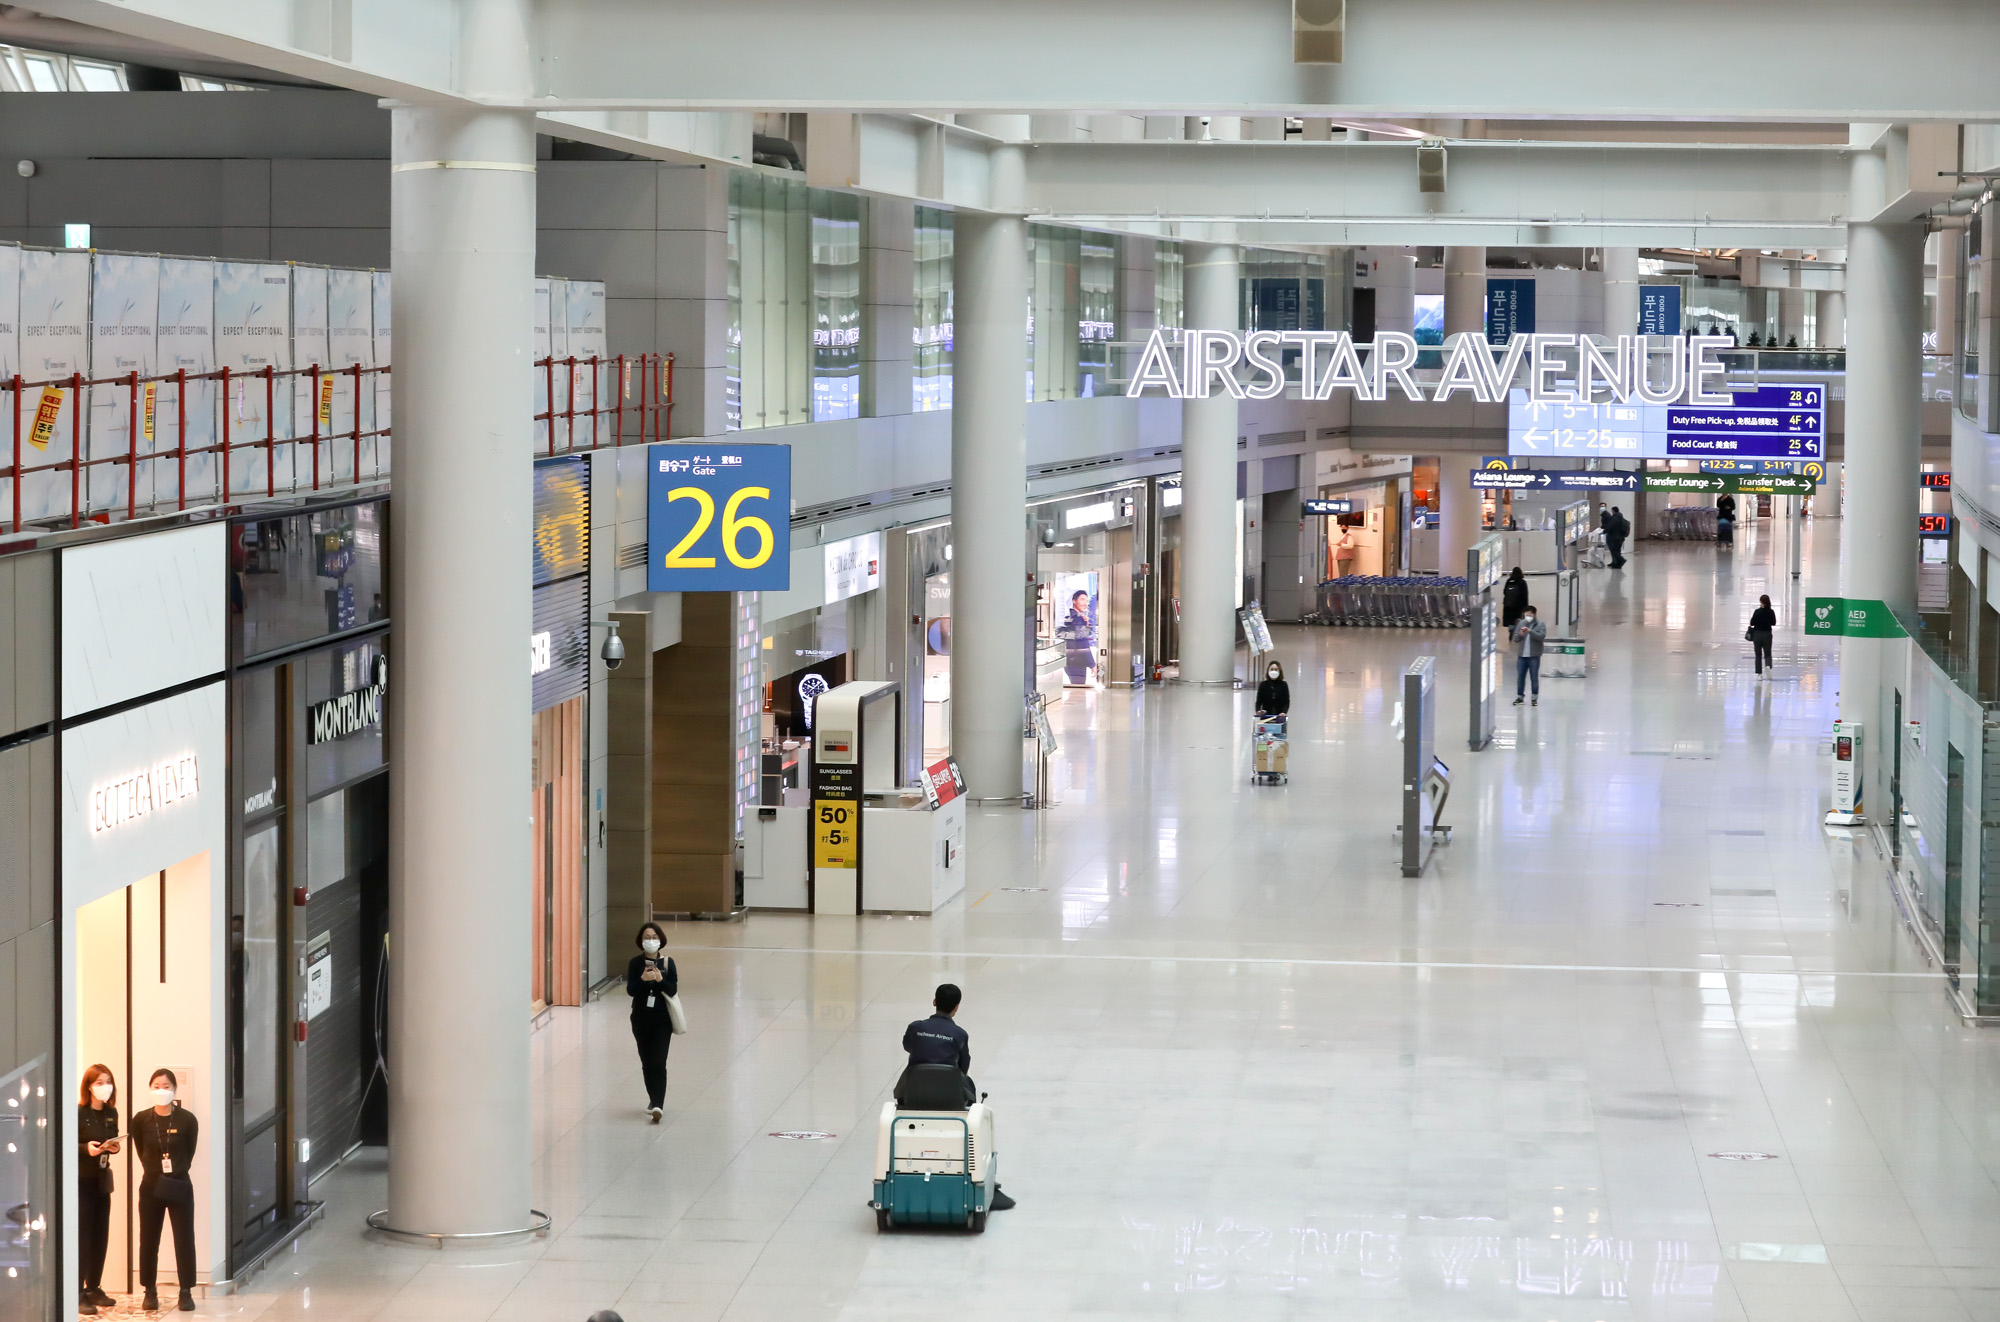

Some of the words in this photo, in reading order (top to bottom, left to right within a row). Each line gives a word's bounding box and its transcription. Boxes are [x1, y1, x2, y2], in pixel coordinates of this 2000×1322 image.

[1644, 295, 1656, 335] 푸드코
[27, 326, 46, 336] EXPECT
[49, 326, 82, 336] EXCEPTIONAL
[100, 326, 118, 336] EXPECT
[121, 326, 152, 336] EXCEPTIONAL
[159, 326, 176, 335] EXPECT
[179, 326, 209, 335] EXCEPTIONAL
[223, 326, 243, 336] EXPECT
[247, 326, 283, 336] EXCEPTIONAL
[1126, 329, 1424, 401] AIRSTAR
[1433, 332, 1736, 406] AVENUE
[1790, 391, 1802, 401] 28
[1672, 415, 1690, 426] Duty
[1690, 416, 1706, 425] Free
[1789, 415, 1801, 425] 4F
[1551, 429, 1612, 448] 12-25
[1672, 440, 1692, 448] Food
[1789, 439, 1801, 450] 25
[693, 455, 711, 464] ゲート
[1709, 460, 1736, 469] 12-25
[659, 460, 690, 472] 탑승구
[692, 466, 716, 475] Gate
[1764, 461, 1785, 470] 5-11
[1473, 472, 1502, 481] Asiana
[1503, 472, 1536, 483] Lounge
[1645, 477, 1677, 486] Transfer
[1678, 478, 1709, 488] Lounge
[1738, 477, 1774, 486] Transfer
[1774, 478, 1796, 487] Desk
[1925, 474, 1950, 486] 11:5
[665, 486, 775, 569] 26
[1848, 610, 1866, 619] AED
[314, 684, 380, 745] MONTBLANC
[95, 772, 153, 833] BOTTEGA
[155, 755, 200, 806] VENETA
[244, 787, 274, 815] MONTBLANC
[936, 1033, 954, 1041] Airport
